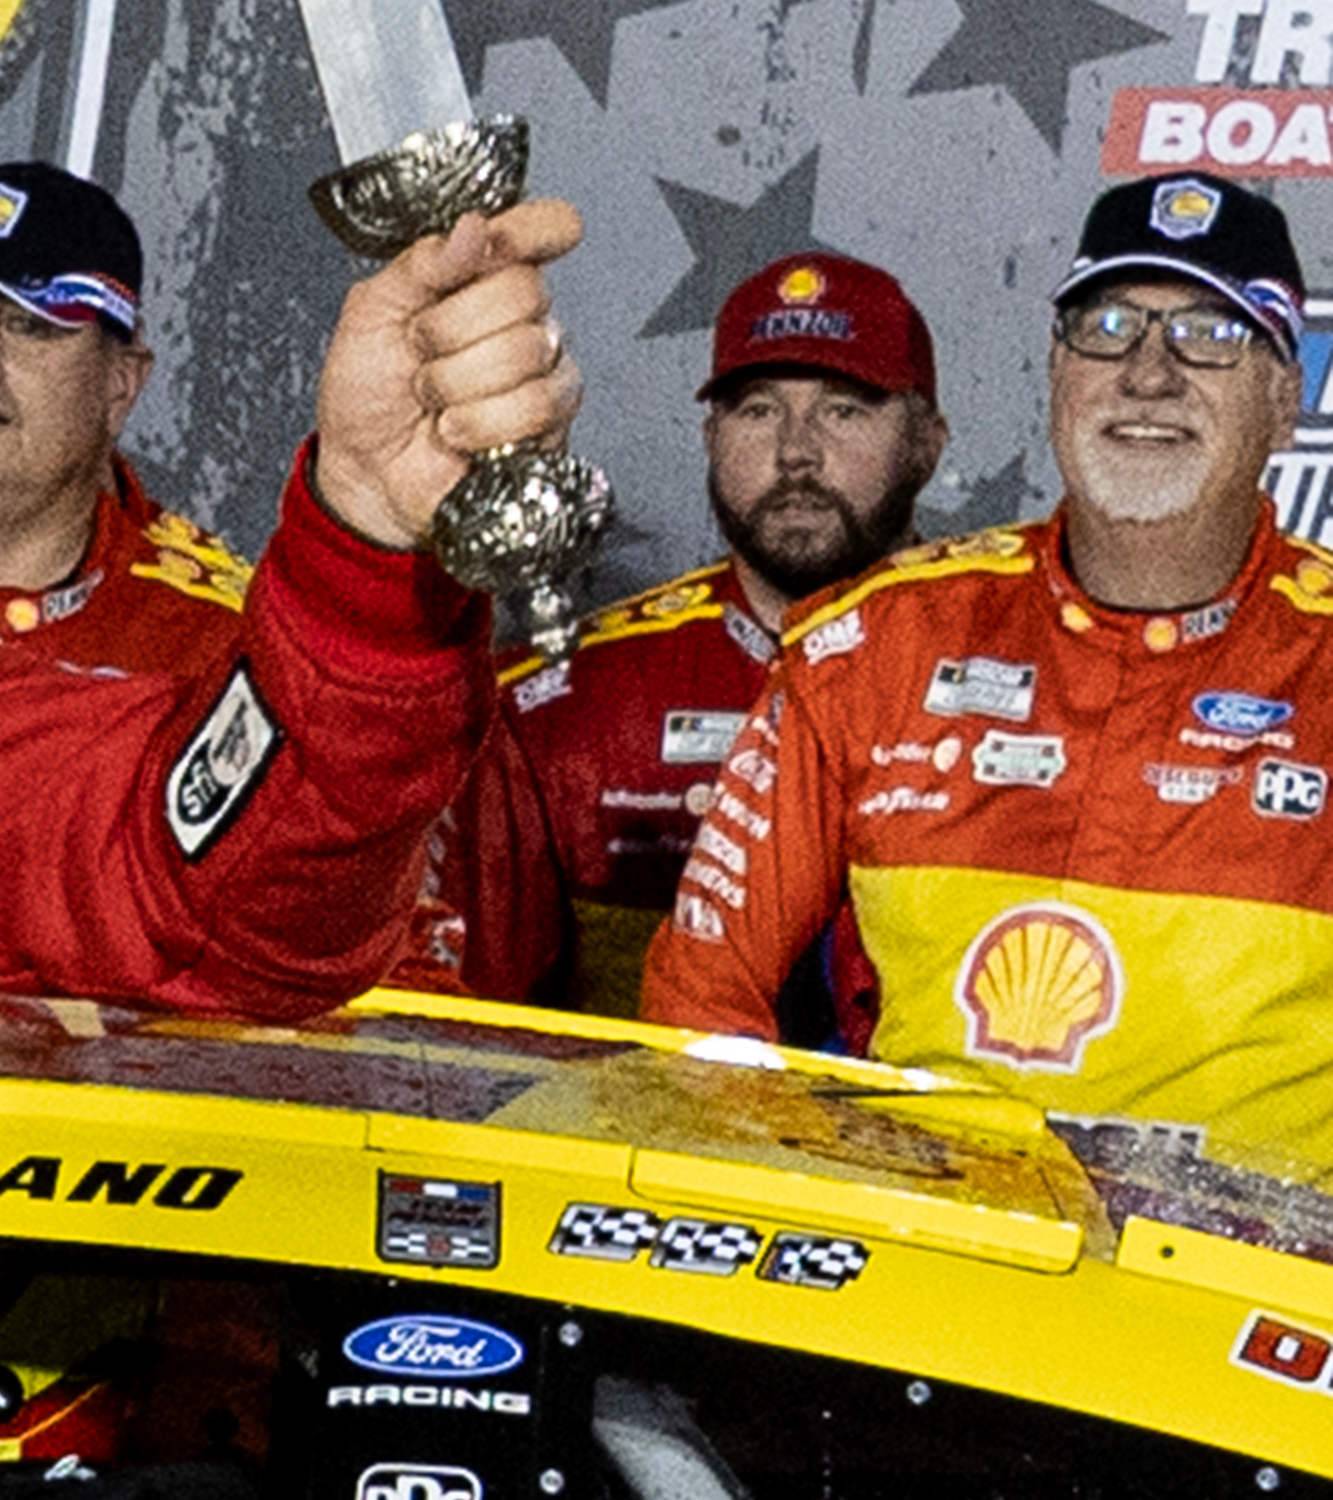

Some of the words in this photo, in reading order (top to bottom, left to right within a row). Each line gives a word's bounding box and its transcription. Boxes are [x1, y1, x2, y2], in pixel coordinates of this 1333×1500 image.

[1257, 764, 1324, 811] PPG
[374, 1323, 487, 1368] Ford
[327, 1384, 532, 1414] RACING
